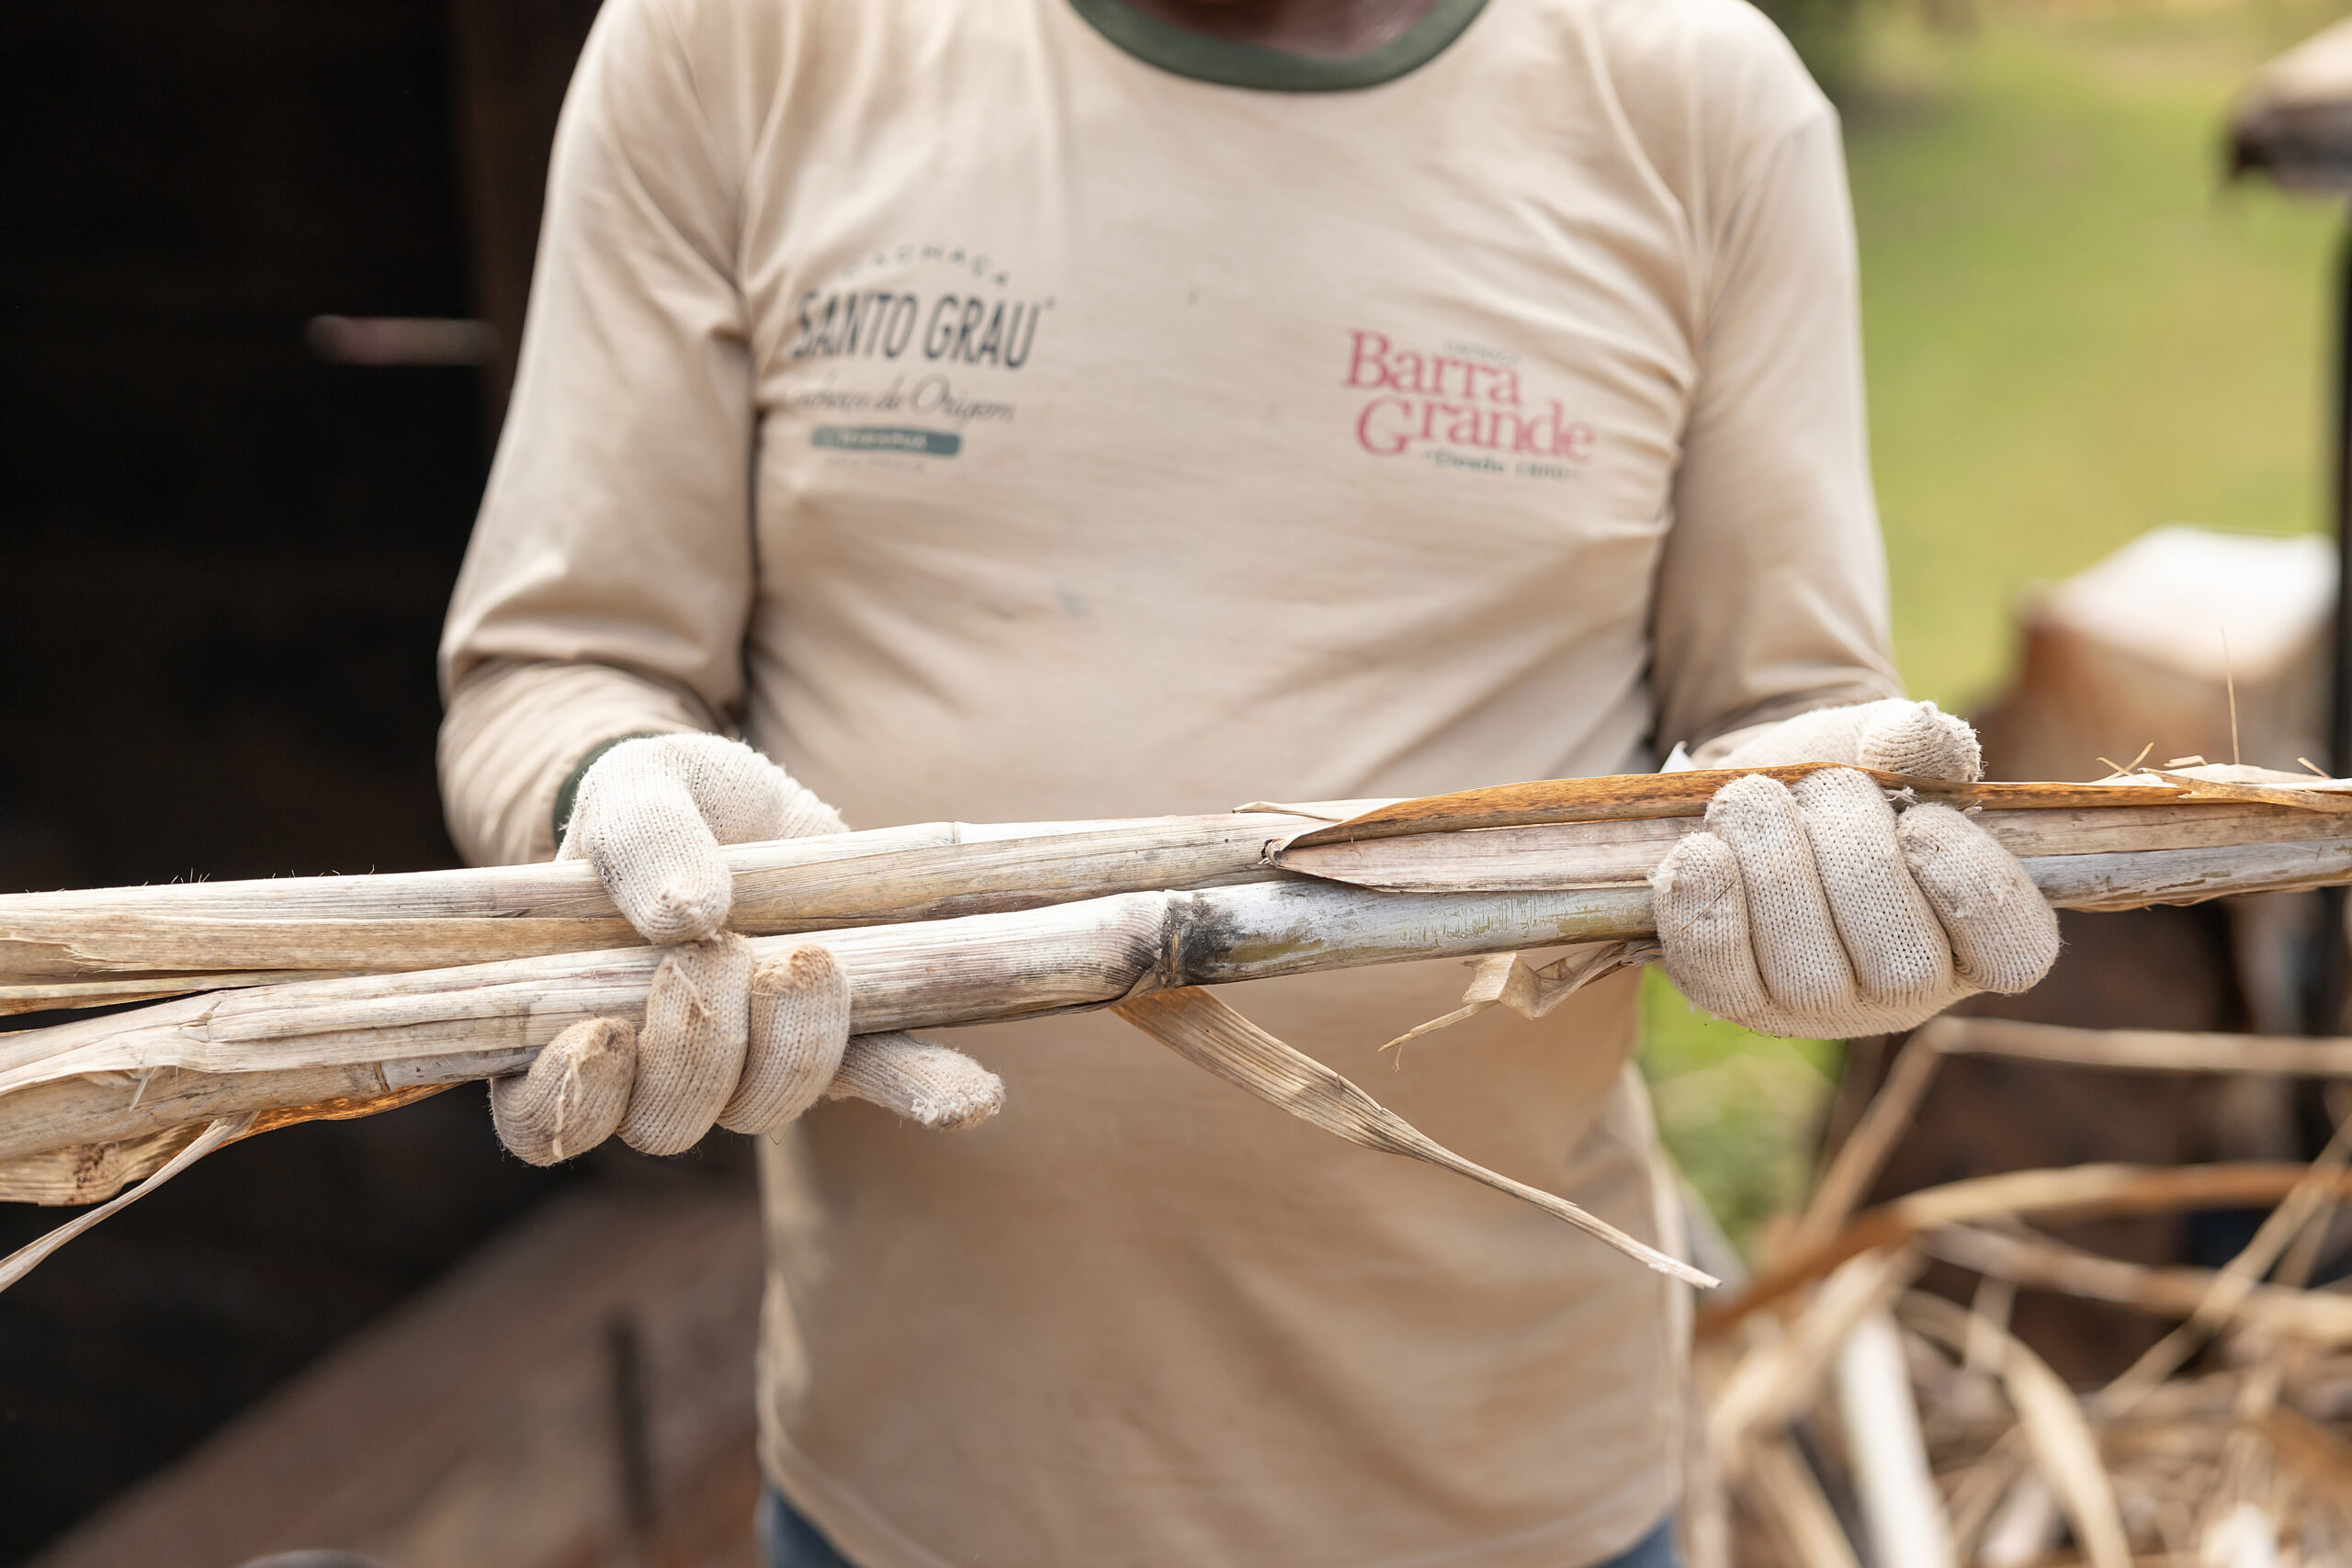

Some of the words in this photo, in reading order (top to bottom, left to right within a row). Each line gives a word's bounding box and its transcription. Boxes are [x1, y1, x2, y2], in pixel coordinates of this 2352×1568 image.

[793, 288, 919, 358] SANTO
[924, 293, 1042, 368] GRAU
[1341, 329, 1522, 407] Barra
[1354, 393, 1597, 466] Grande
